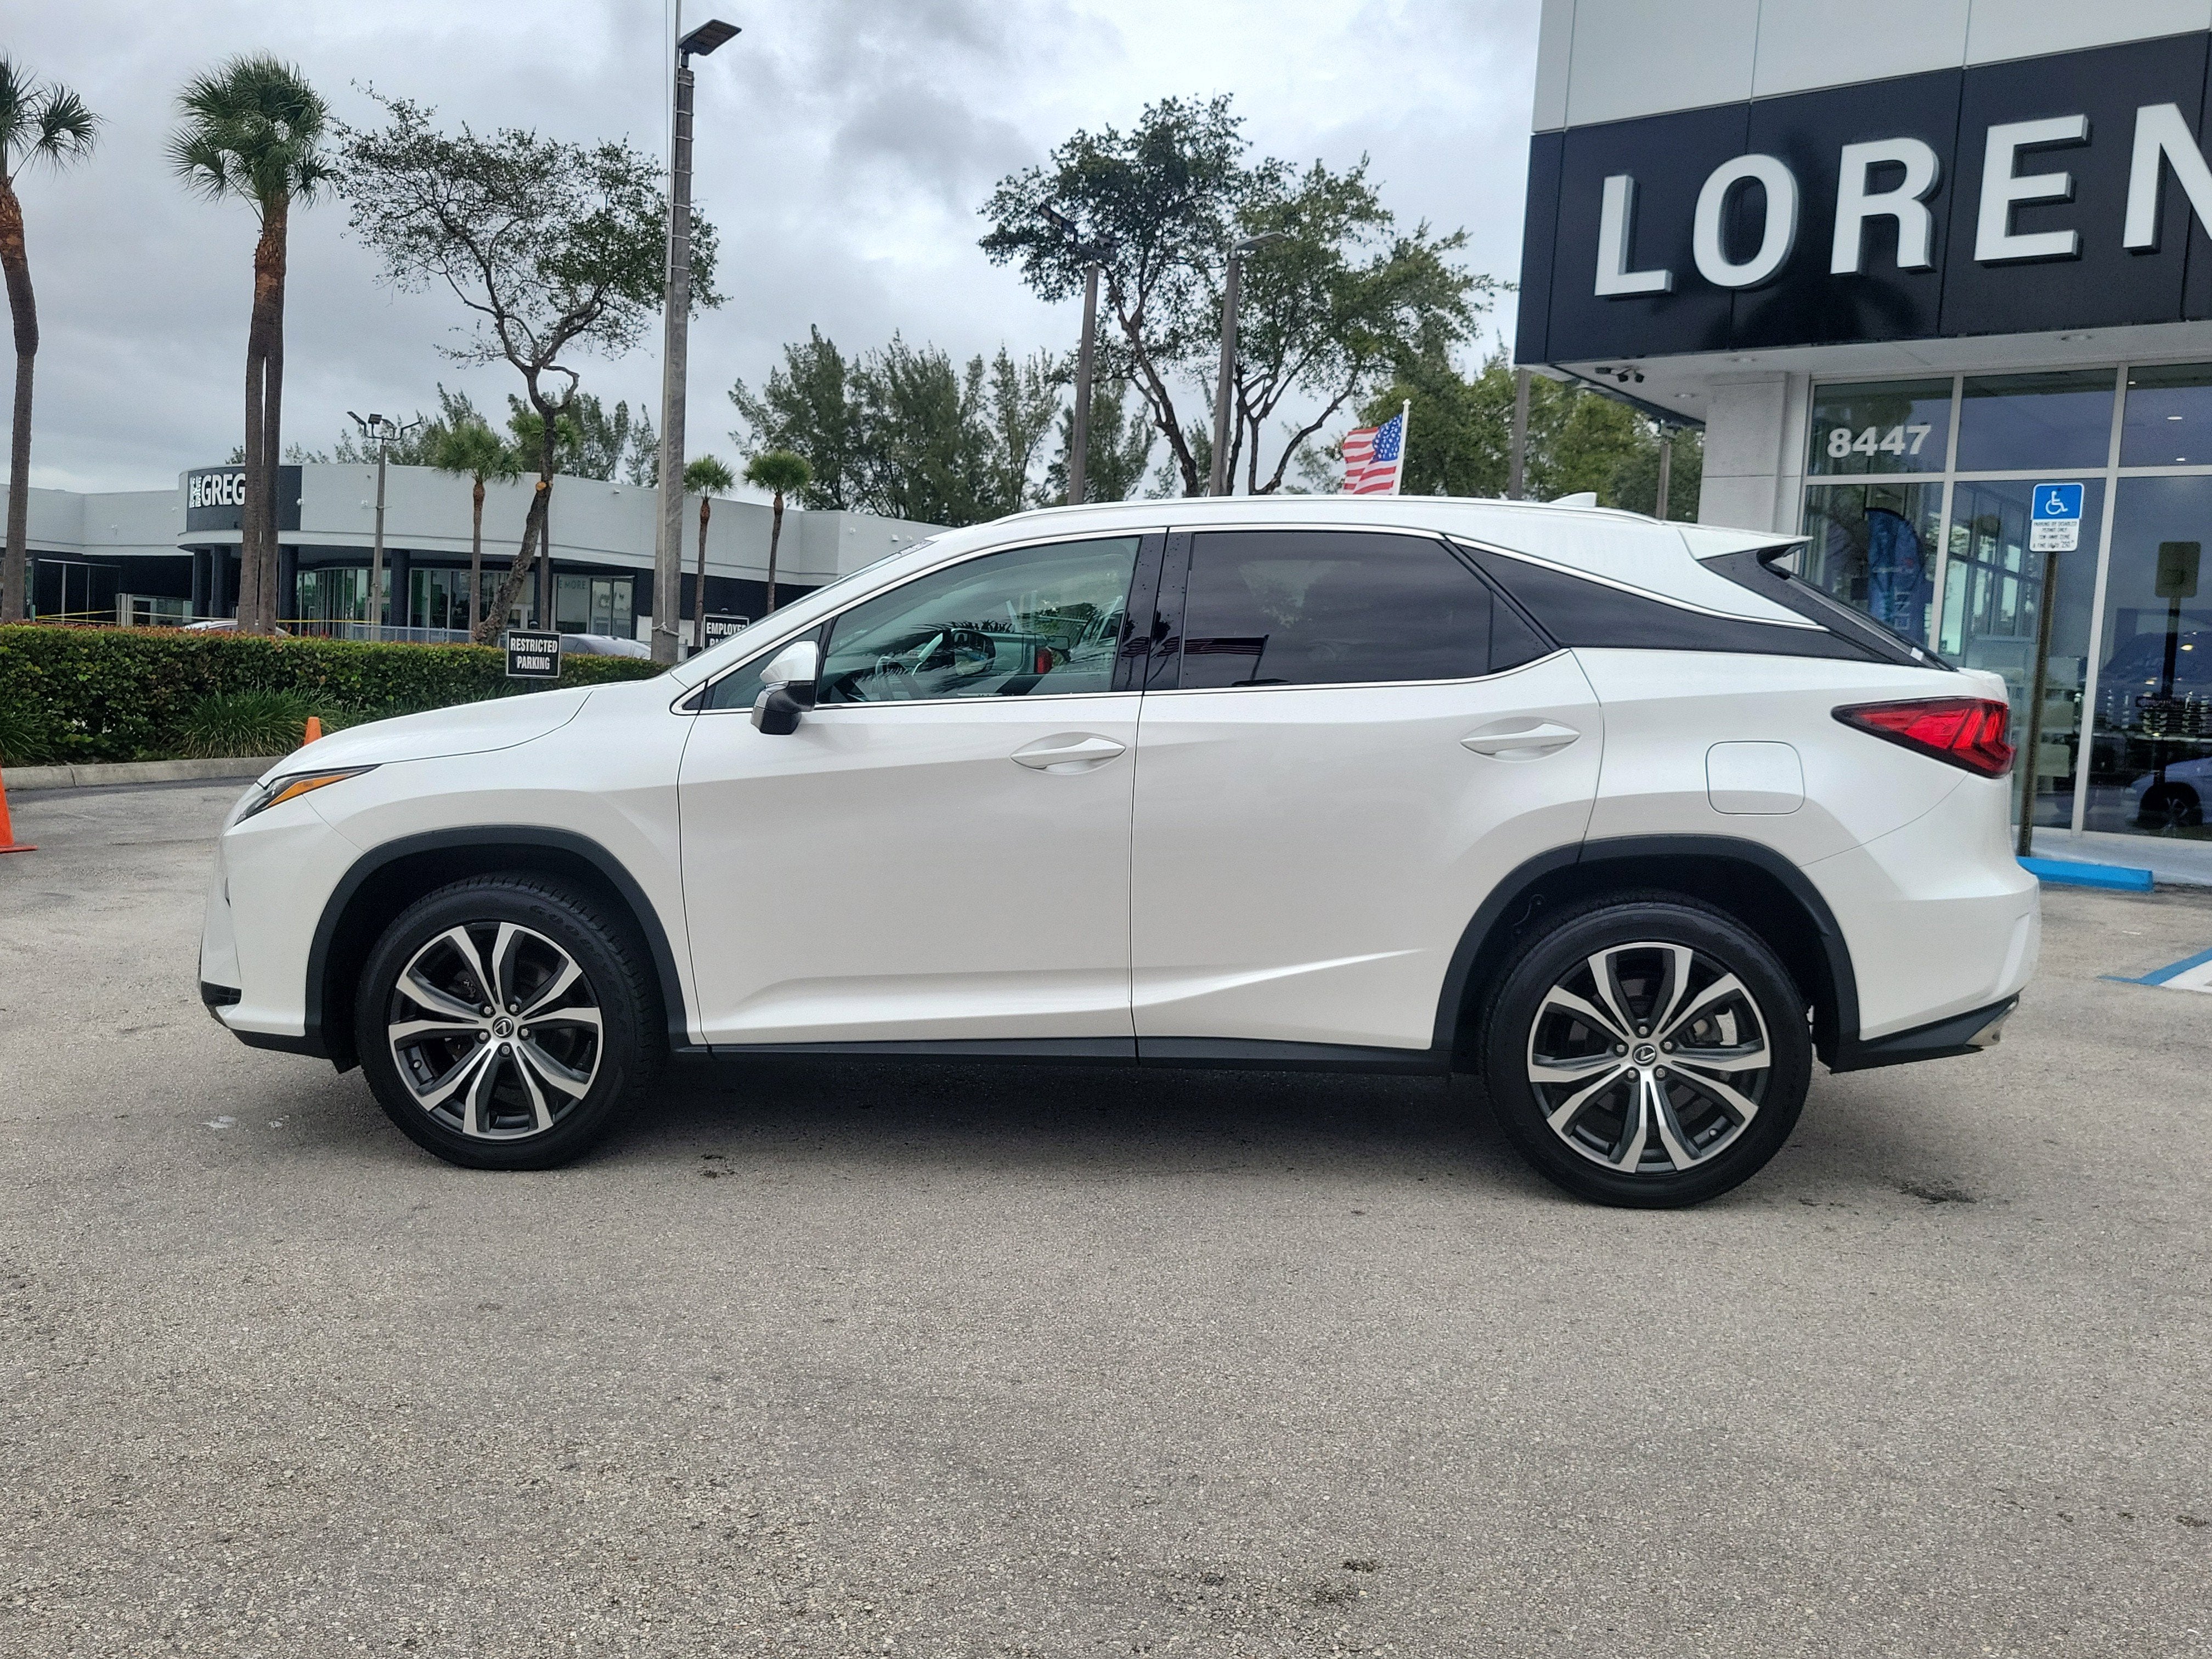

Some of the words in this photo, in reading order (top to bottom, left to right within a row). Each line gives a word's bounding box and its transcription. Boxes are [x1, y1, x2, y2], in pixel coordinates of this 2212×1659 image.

[1594, 102, 2212, 296] LOREN
[1827, 425, 1931, 458] 8447
[510, 637, 557, 653] RESTRICTED
[516, 656, 550, 670] PARKING
